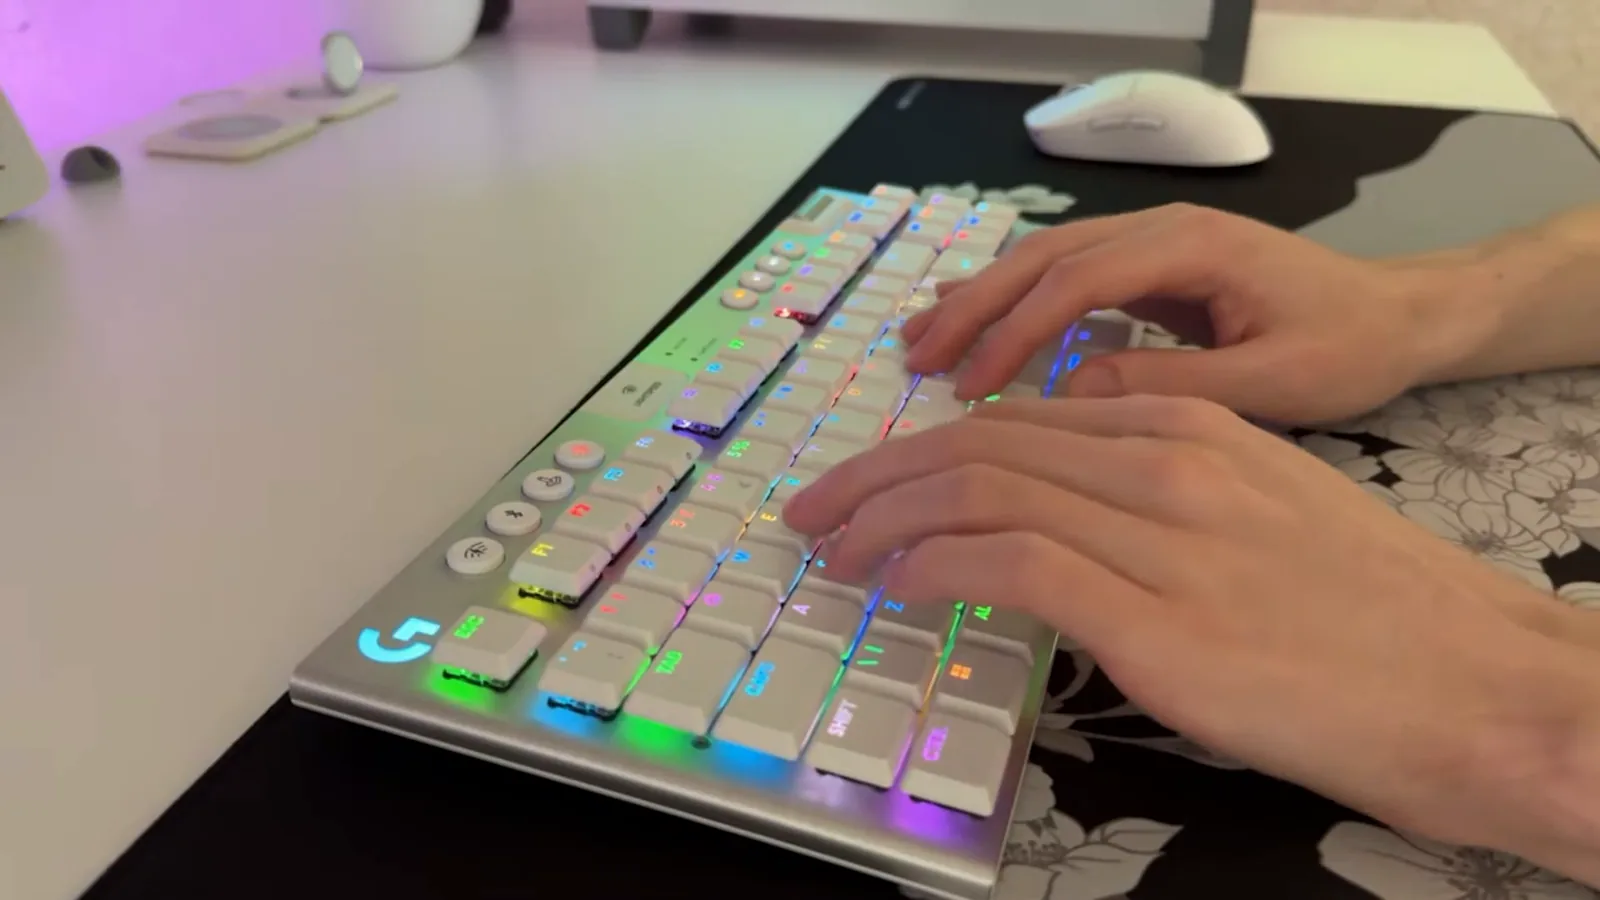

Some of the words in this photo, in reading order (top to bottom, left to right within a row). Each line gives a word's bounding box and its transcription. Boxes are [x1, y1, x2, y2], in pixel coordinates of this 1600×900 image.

[603, 466, 625, 482] F3
[567, 503, 593, 518] F2
[760, 512, 777, 523] E
[531, 543, 554, 557] F1
[730, 549, 751, 563] W
[792, 603, 811, 616] A
[884, 600, 905, 613] Z
[453, 614, 485, 639] ESC
[655, 650, 683, 676] TAB
[744, 661, 776, 697] CAPS
[827, 698, 858, 737] SHIFT
[922, 726, 949, 761] CTRL
